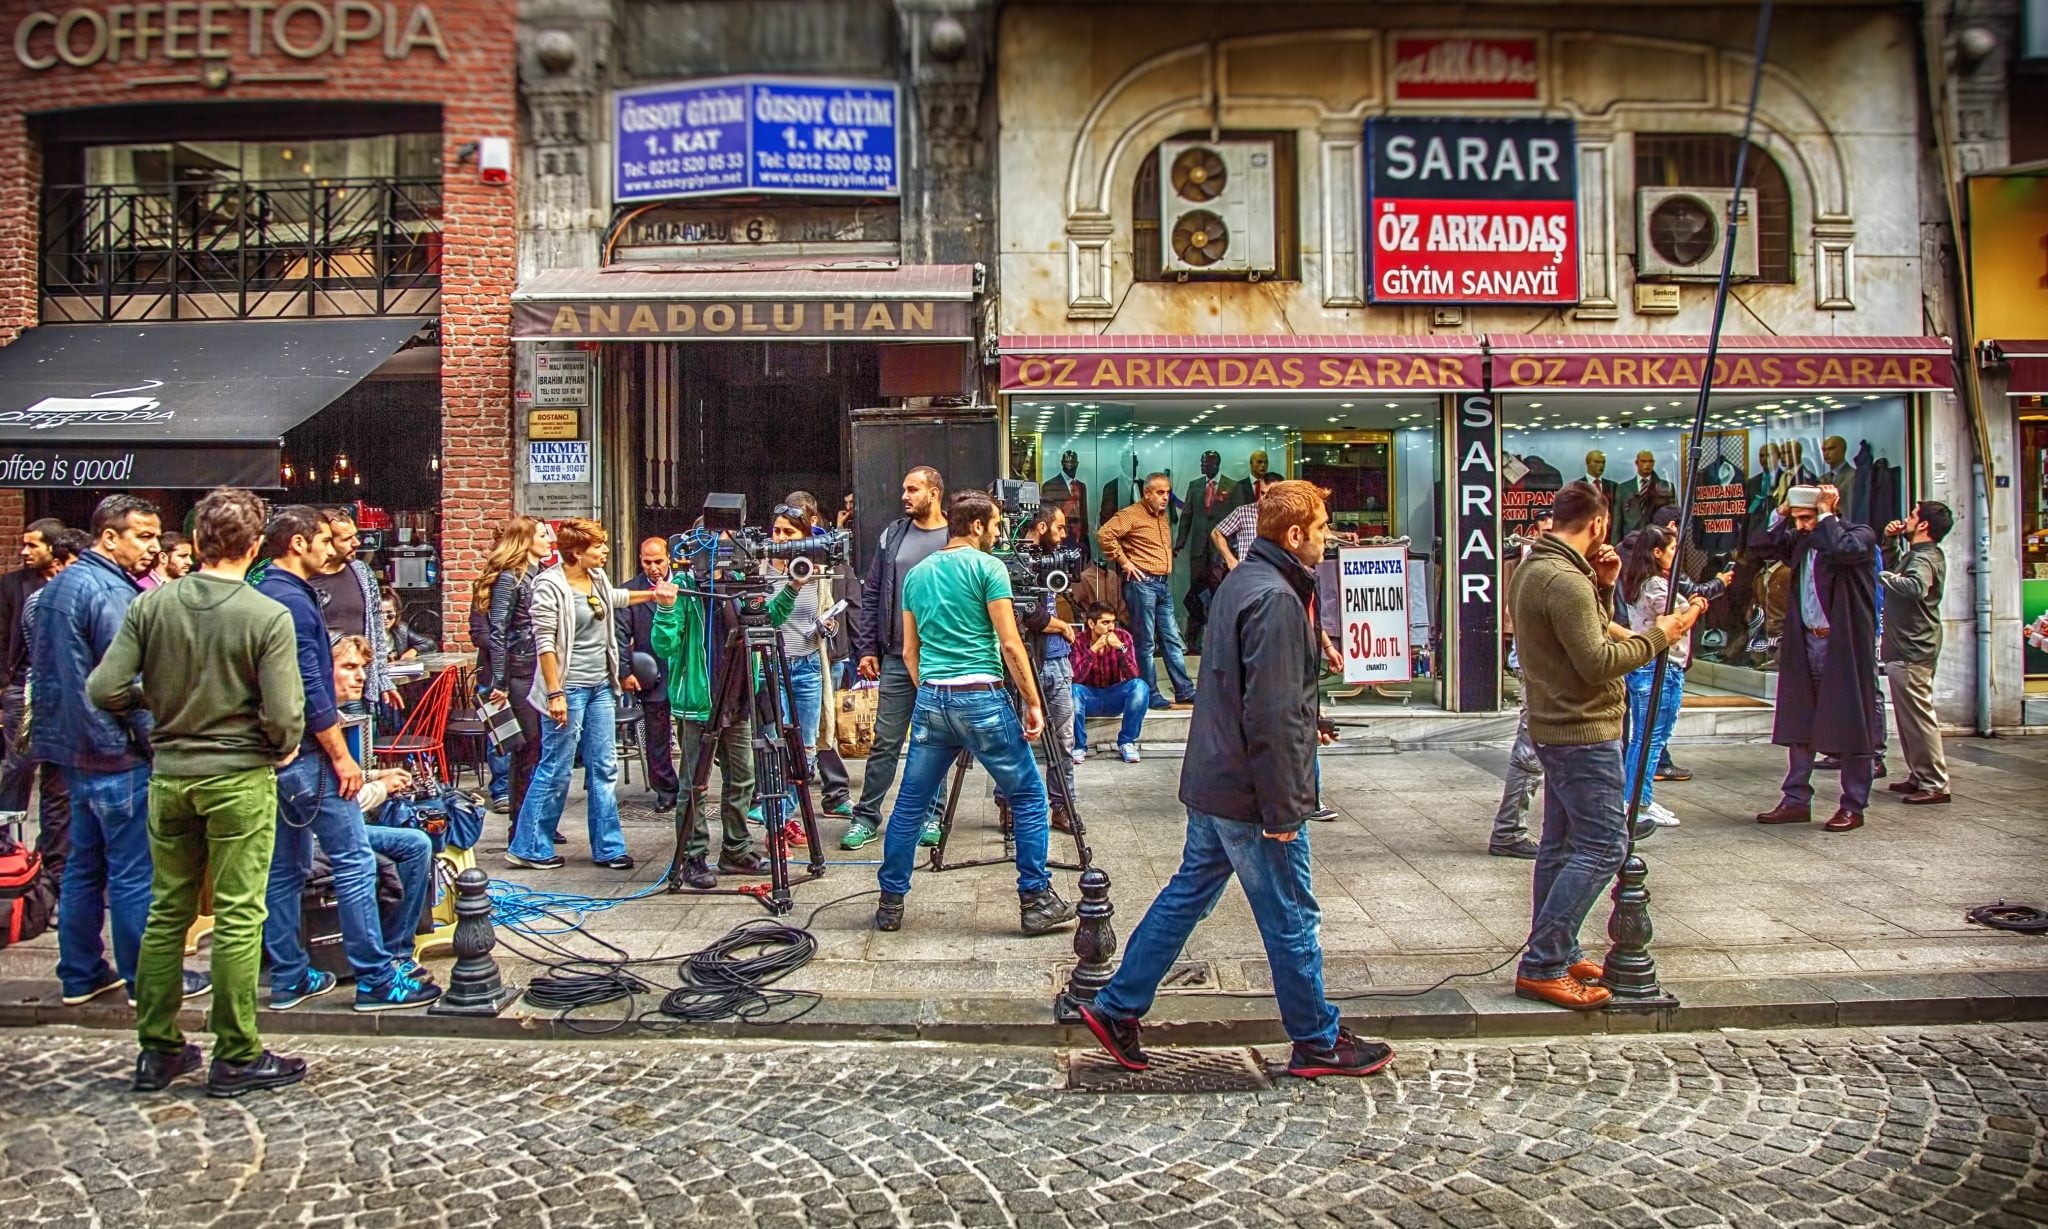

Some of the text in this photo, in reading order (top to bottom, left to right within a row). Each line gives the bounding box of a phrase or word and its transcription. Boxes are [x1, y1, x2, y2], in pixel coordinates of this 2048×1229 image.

[14, 0, 450, 70] COFFEETOPIA
[622, 90, 745, 133] ÖZSOY GİYİM
[756, 86, 892, 126] ÖZSOY GİYİM
[644, 128, 722, 156] 1. KAT
[782, 126, 868, 152] 1. KAT
[648, 158, 680, 176] 0212
[681, 155, 706, 173] 520
[707, 153, 725, 170] 05
[726, 152, 745, 169] 33
[756, 150, 892, 172] Tel: 0212 520 05 33
[1385, 135, 1560, 182] SARAR
[624, 171, 742, 192] www.ozsoygiyim.net
[758, 171, 890, 187] www.ozsoygiyim.net
[745, 219, 764, 242] 6
[1378, 202, 1568, 264] ÖZ ARKADAŞ
[1382, 264, 1559, 296] GİYİM SANAYİİ
[550, 301, 935, 333] ANADOLU HAN
[564, 375, 585, 385] AYHAN
[1091, 358, 1305, 388] ARKADAŞ
[1319, 358, 1466, 387] SARAR
[1579, 358, 1782, 387] ARKADAŞ
[1796, 358, 1935, 386] SARAR
[537, 413, 569, 421] BOSTANCI
[530, 454, 588, 464] NAKLİYAT
[531, 441, 588, 454] HİKMET
[51, 454, 69, 481] is
[72, 453, 135, 486] good!
[1460, 396, 1495, 604] SARAR
[1696, 483, 1745, 499] KAMPANYA
[1691, 499, 1746, 516] ALTINYILDIZ
[1704, 518, 1733, 533] TAKIM
[1344, 560, 1403, 576] KAMPANYA
[1345, 586, 1404, 613] PANTALON
[1349, 622, 1400, 660] 30.00 TL
[387, 987, 409, 1003] N
